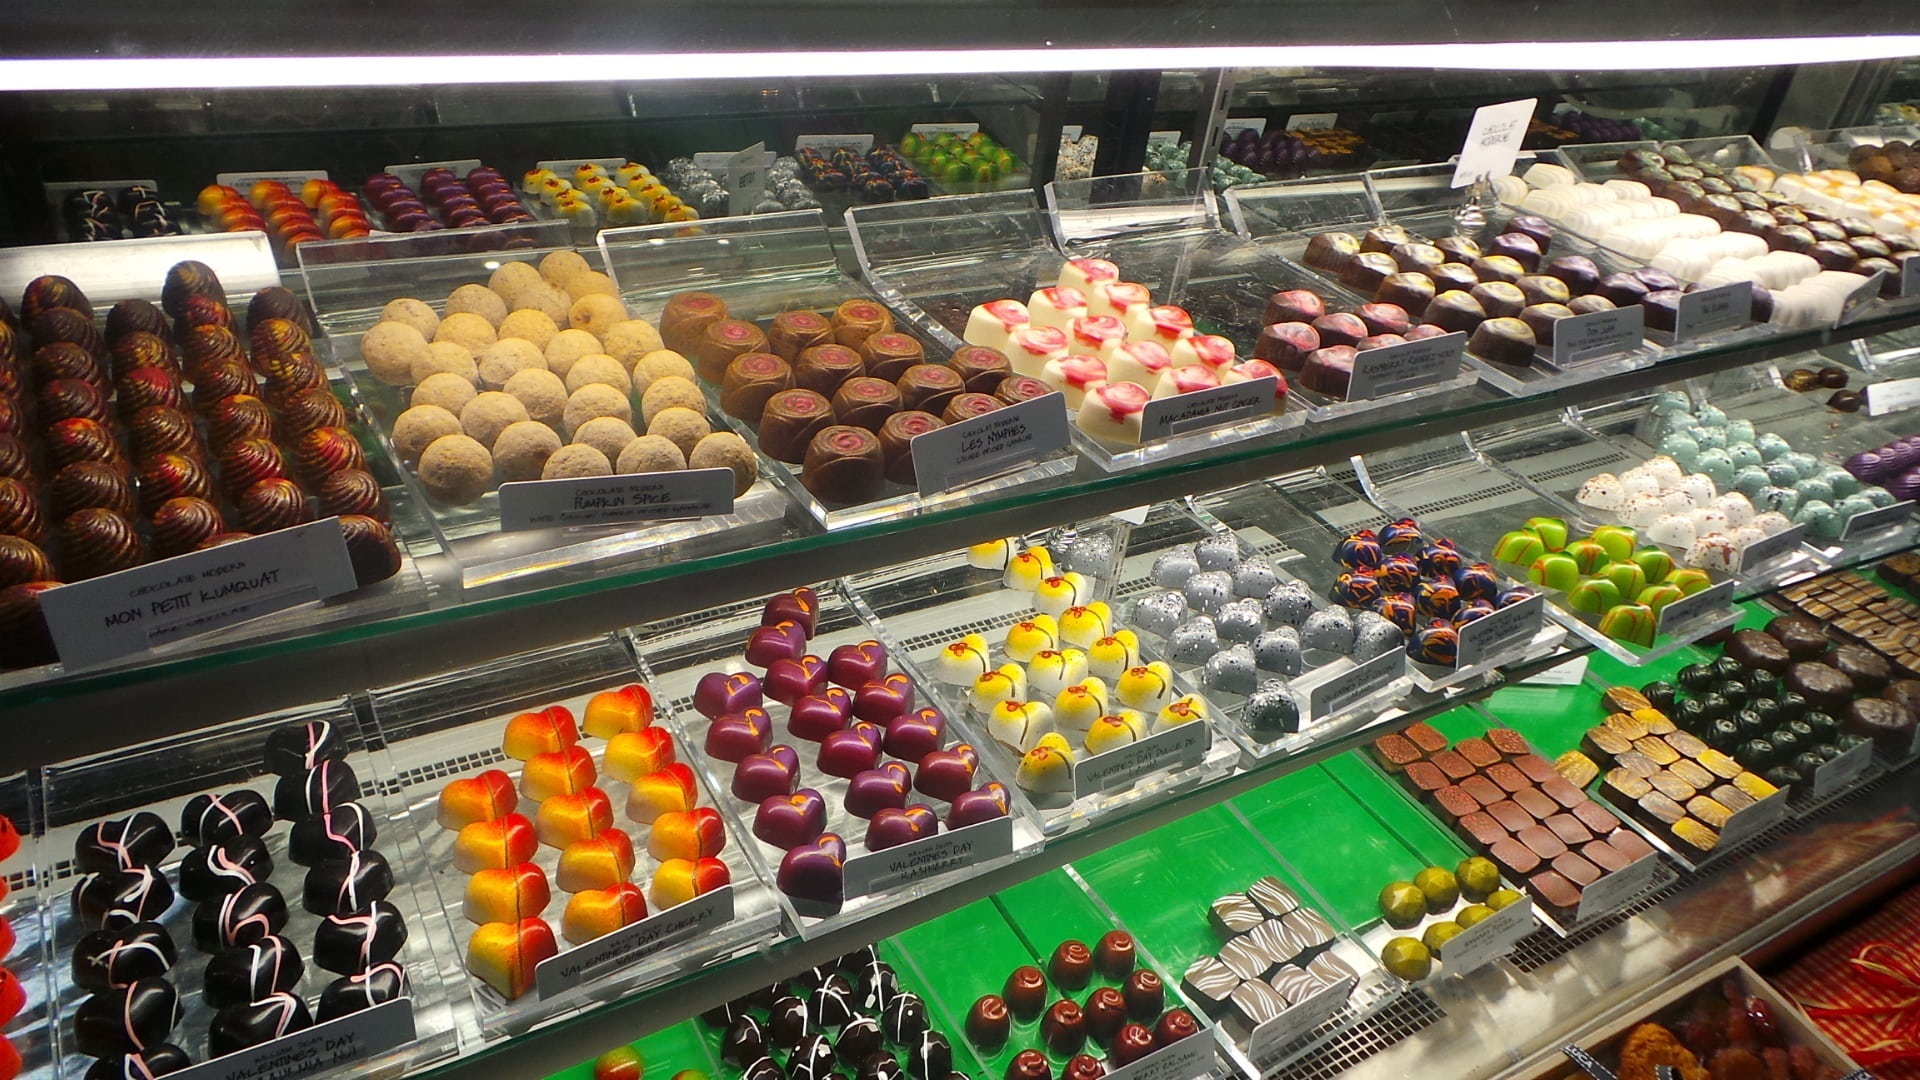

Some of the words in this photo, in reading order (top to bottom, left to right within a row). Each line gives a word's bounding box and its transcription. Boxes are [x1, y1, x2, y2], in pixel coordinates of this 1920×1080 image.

[961, 438, 984, 453] LES
[574, 496, 625, 510] PUMPKIN
[632, 492, 672, 506] SPICE
[129, 574, 197, 599] CHOCOLATE
[202, 561, 246, 578] MODERN
[105, 606, 142, 629] MON
[200, 568, 281, 605] KUMQUAT
[1137, 752, 1153, 763] DAY
[889, 851, 949, 873] VALENTINES
[953, 841, 974, 855] DAY
[560, 944, 632, 978] VALENTINES
[637, 929, 664, 947] DAY
[666, 906, 716, 933] CHERRY
[225, 1047, 318, 1080] VALENTINES
[325, 1031, 356, 1050] DAY
[1564, 1043, 1594, 1069] LUCA
